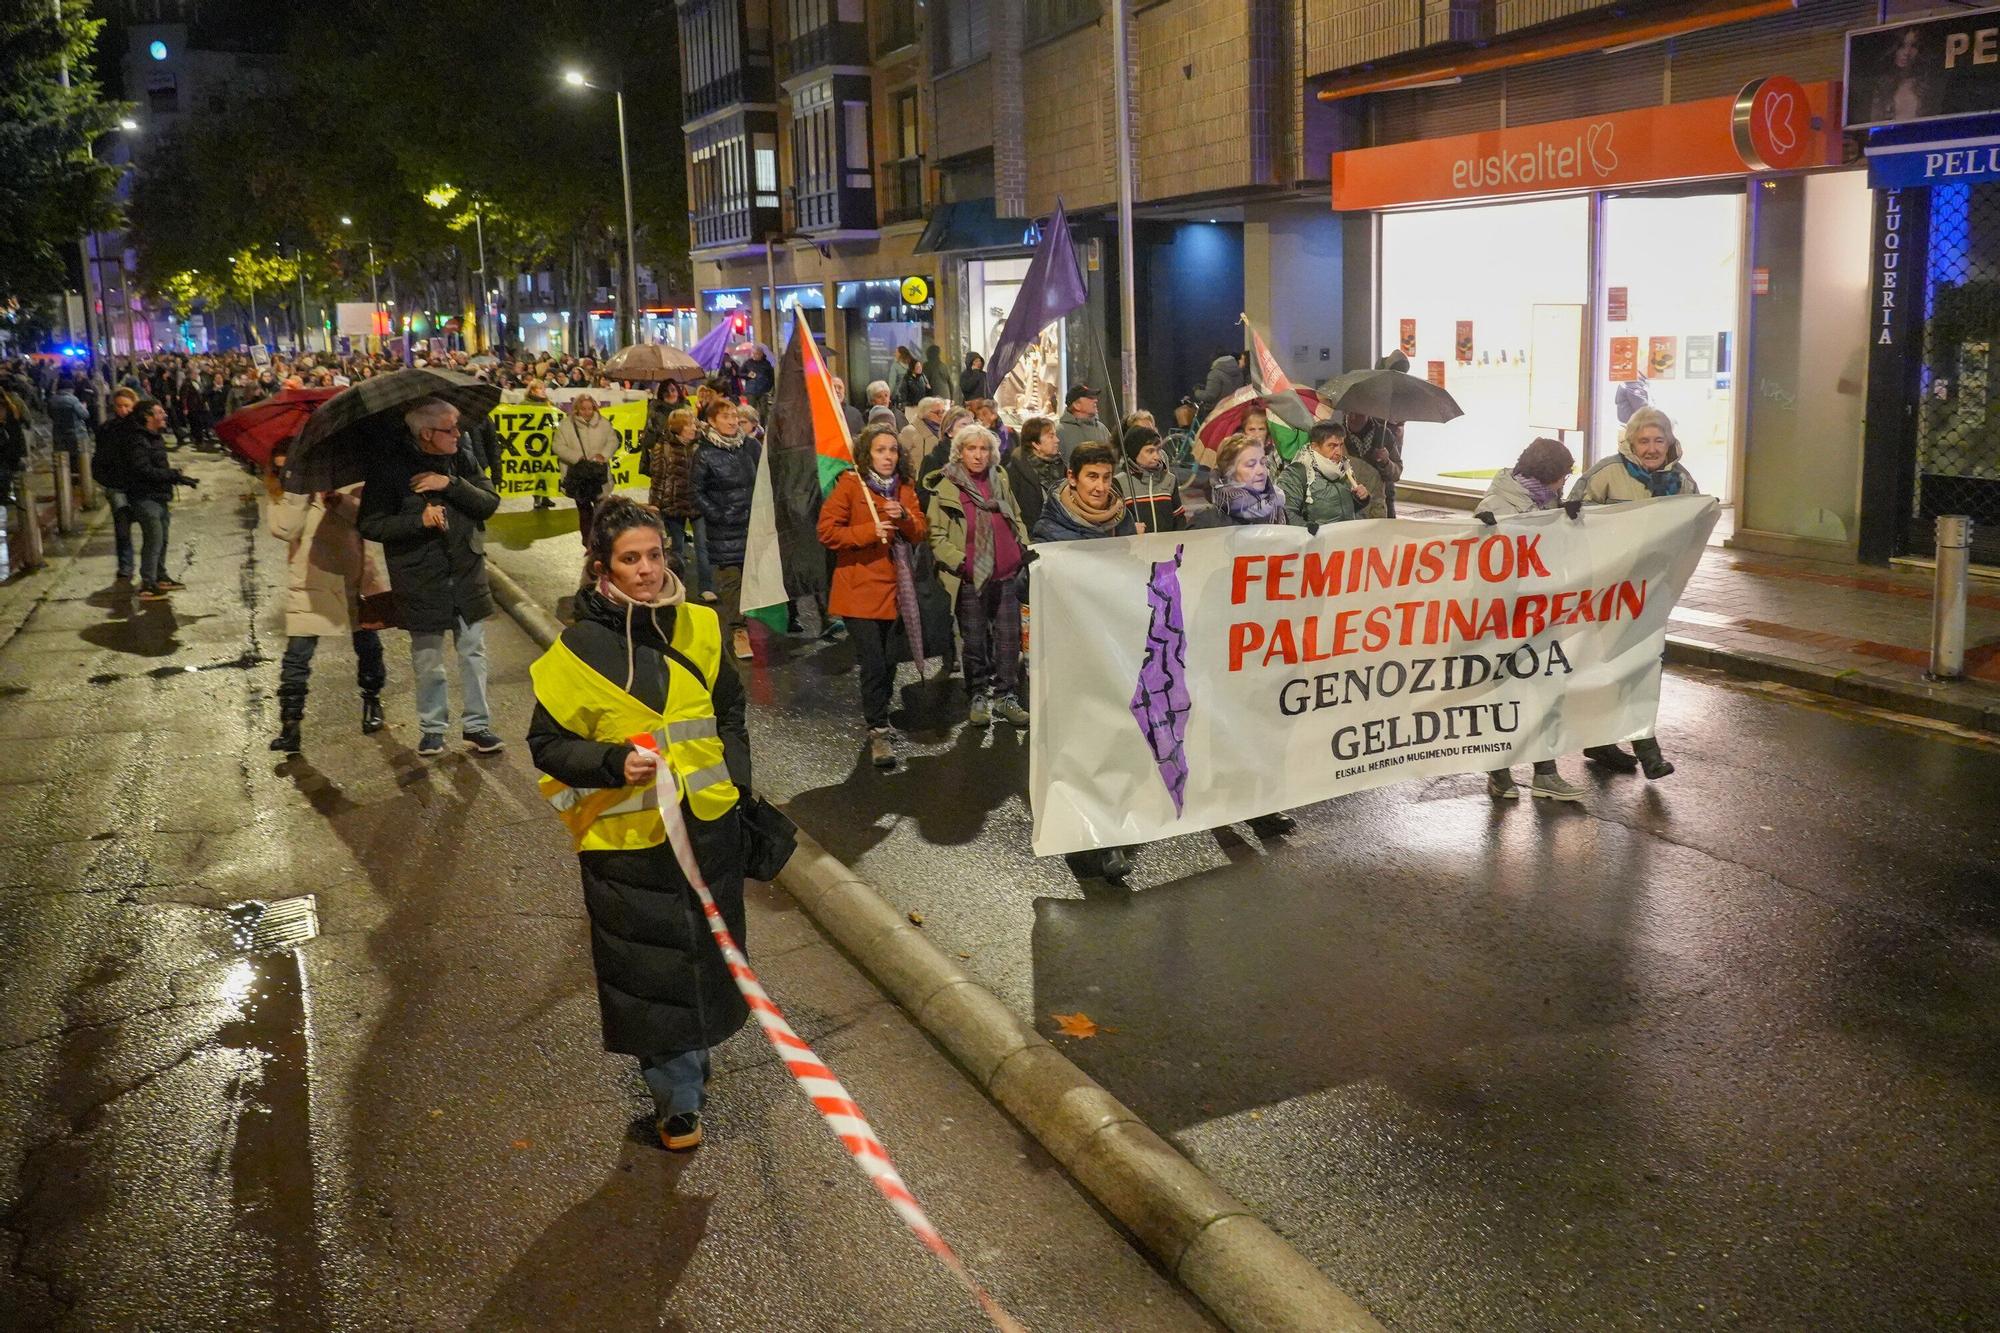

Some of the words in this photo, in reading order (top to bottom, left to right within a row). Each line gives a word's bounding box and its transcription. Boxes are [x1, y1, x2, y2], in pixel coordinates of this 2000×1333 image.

[1452, 136, 1582, 189] euskaltel
[1231, 534, 1552, 604] FEMINISTOK
[1229, 579, 1647, 671] PALESTINAREKIN
[1331, 700, 1520, 761] GELDITU
[1335, 764, 1365, 780] EUSKAL
[1407, 746, 1460, 763] MUGIMENDU
[1462, 741, 1512, 755] FEMINISTA
